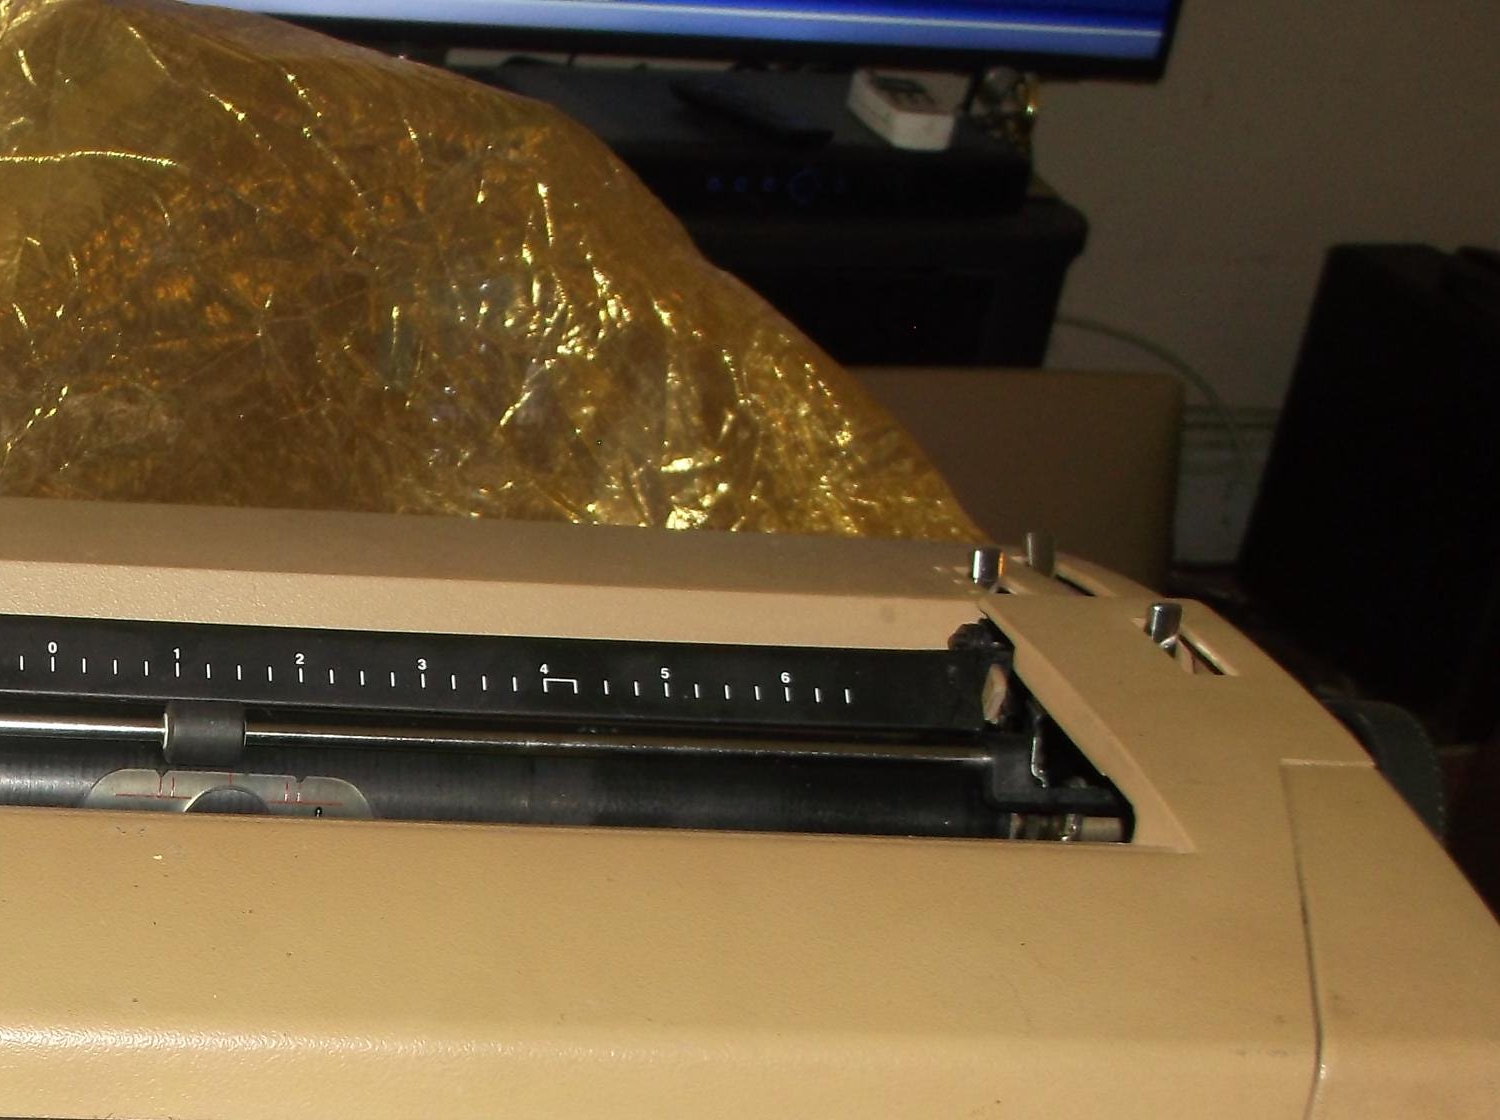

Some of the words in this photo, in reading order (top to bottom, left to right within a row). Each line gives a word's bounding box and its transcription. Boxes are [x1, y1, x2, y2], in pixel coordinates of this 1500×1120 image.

[48, 642, 57, 653] 0
[174, 648, 179, 659] 1
[296, 654, 304, 664] 2
[418, 659, 426, 670] 3
[540, 664, 548, 674] 4
[661, 668, 669, 678] 5
[781, 672, 790, 683] 6
